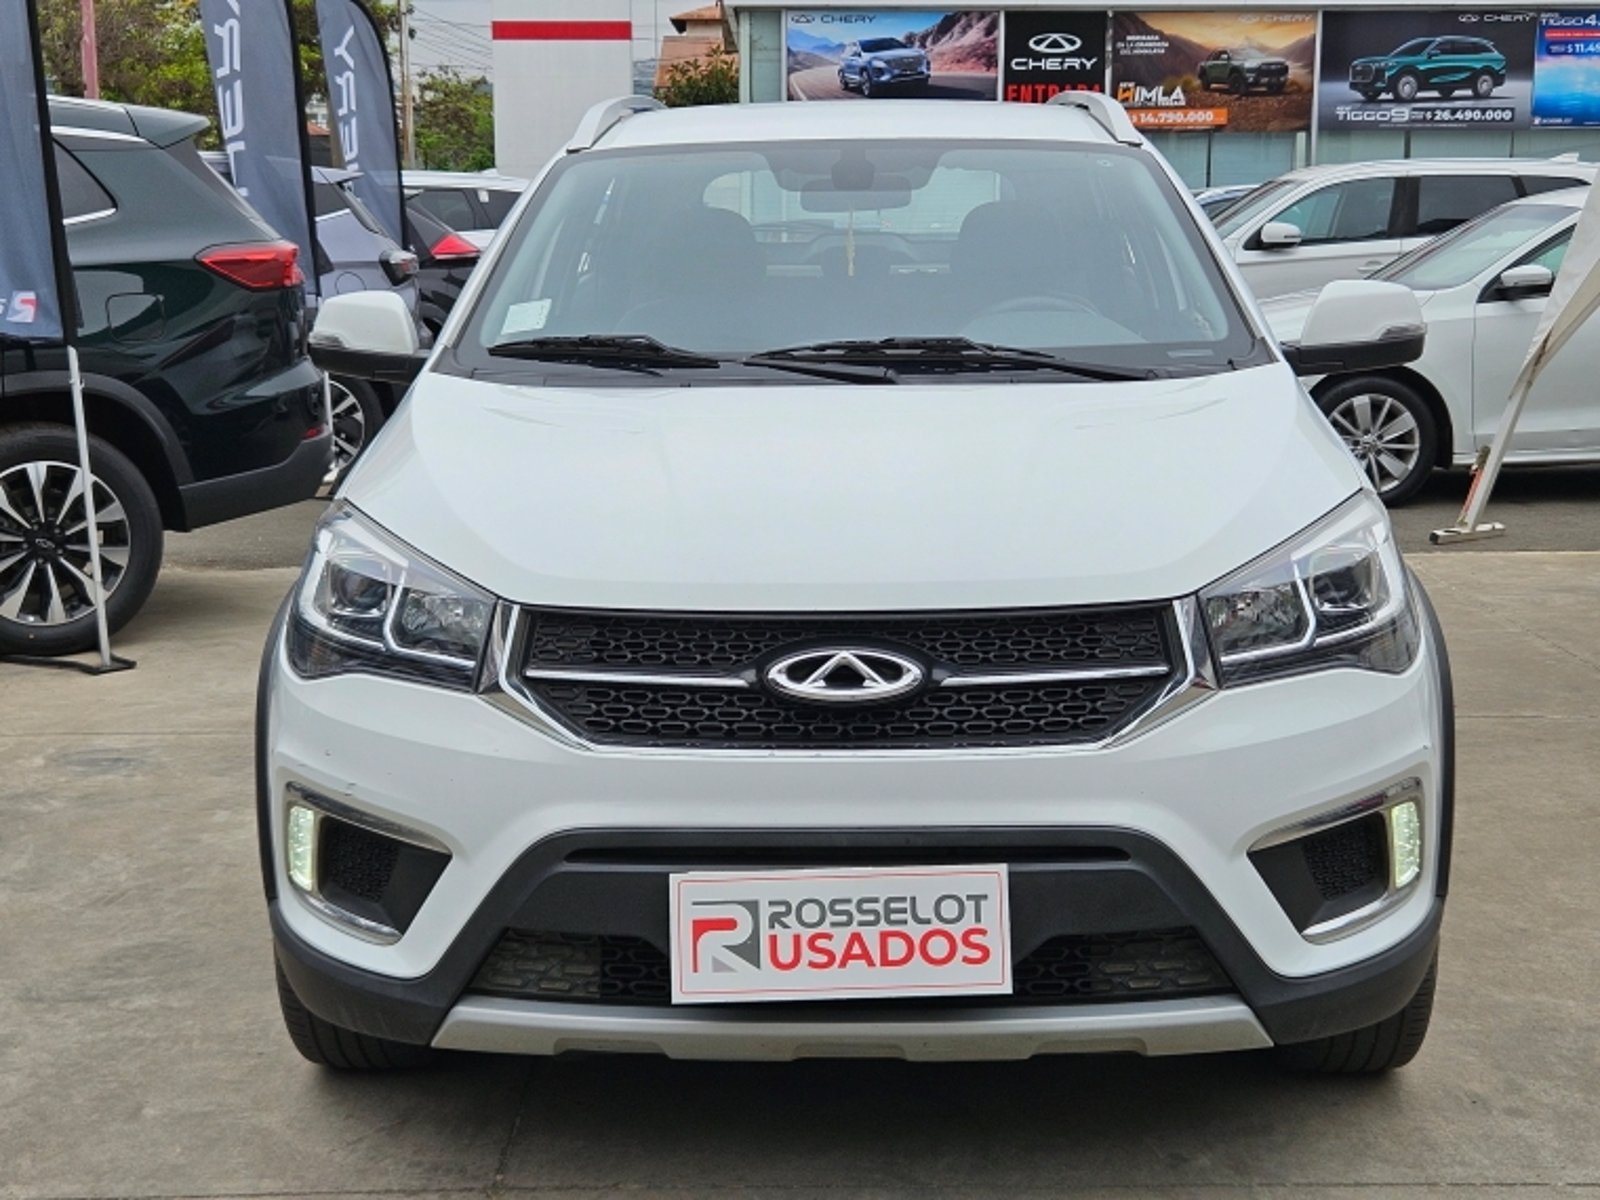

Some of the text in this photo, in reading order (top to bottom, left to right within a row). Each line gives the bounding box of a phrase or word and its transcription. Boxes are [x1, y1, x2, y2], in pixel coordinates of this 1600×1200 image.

[820, 14, 877, 24] CHERY
[1483, 13, 1531, 23] CHERY
[1010, 57, 1098, 71] CHERY
[1007, 83, 1101, 104] ENTR
[1433, 109, 1513, 121] 26.490.000
[767, 893, 989, 930] ROSSELOT
[768, 927, 991, 972] USADOS
